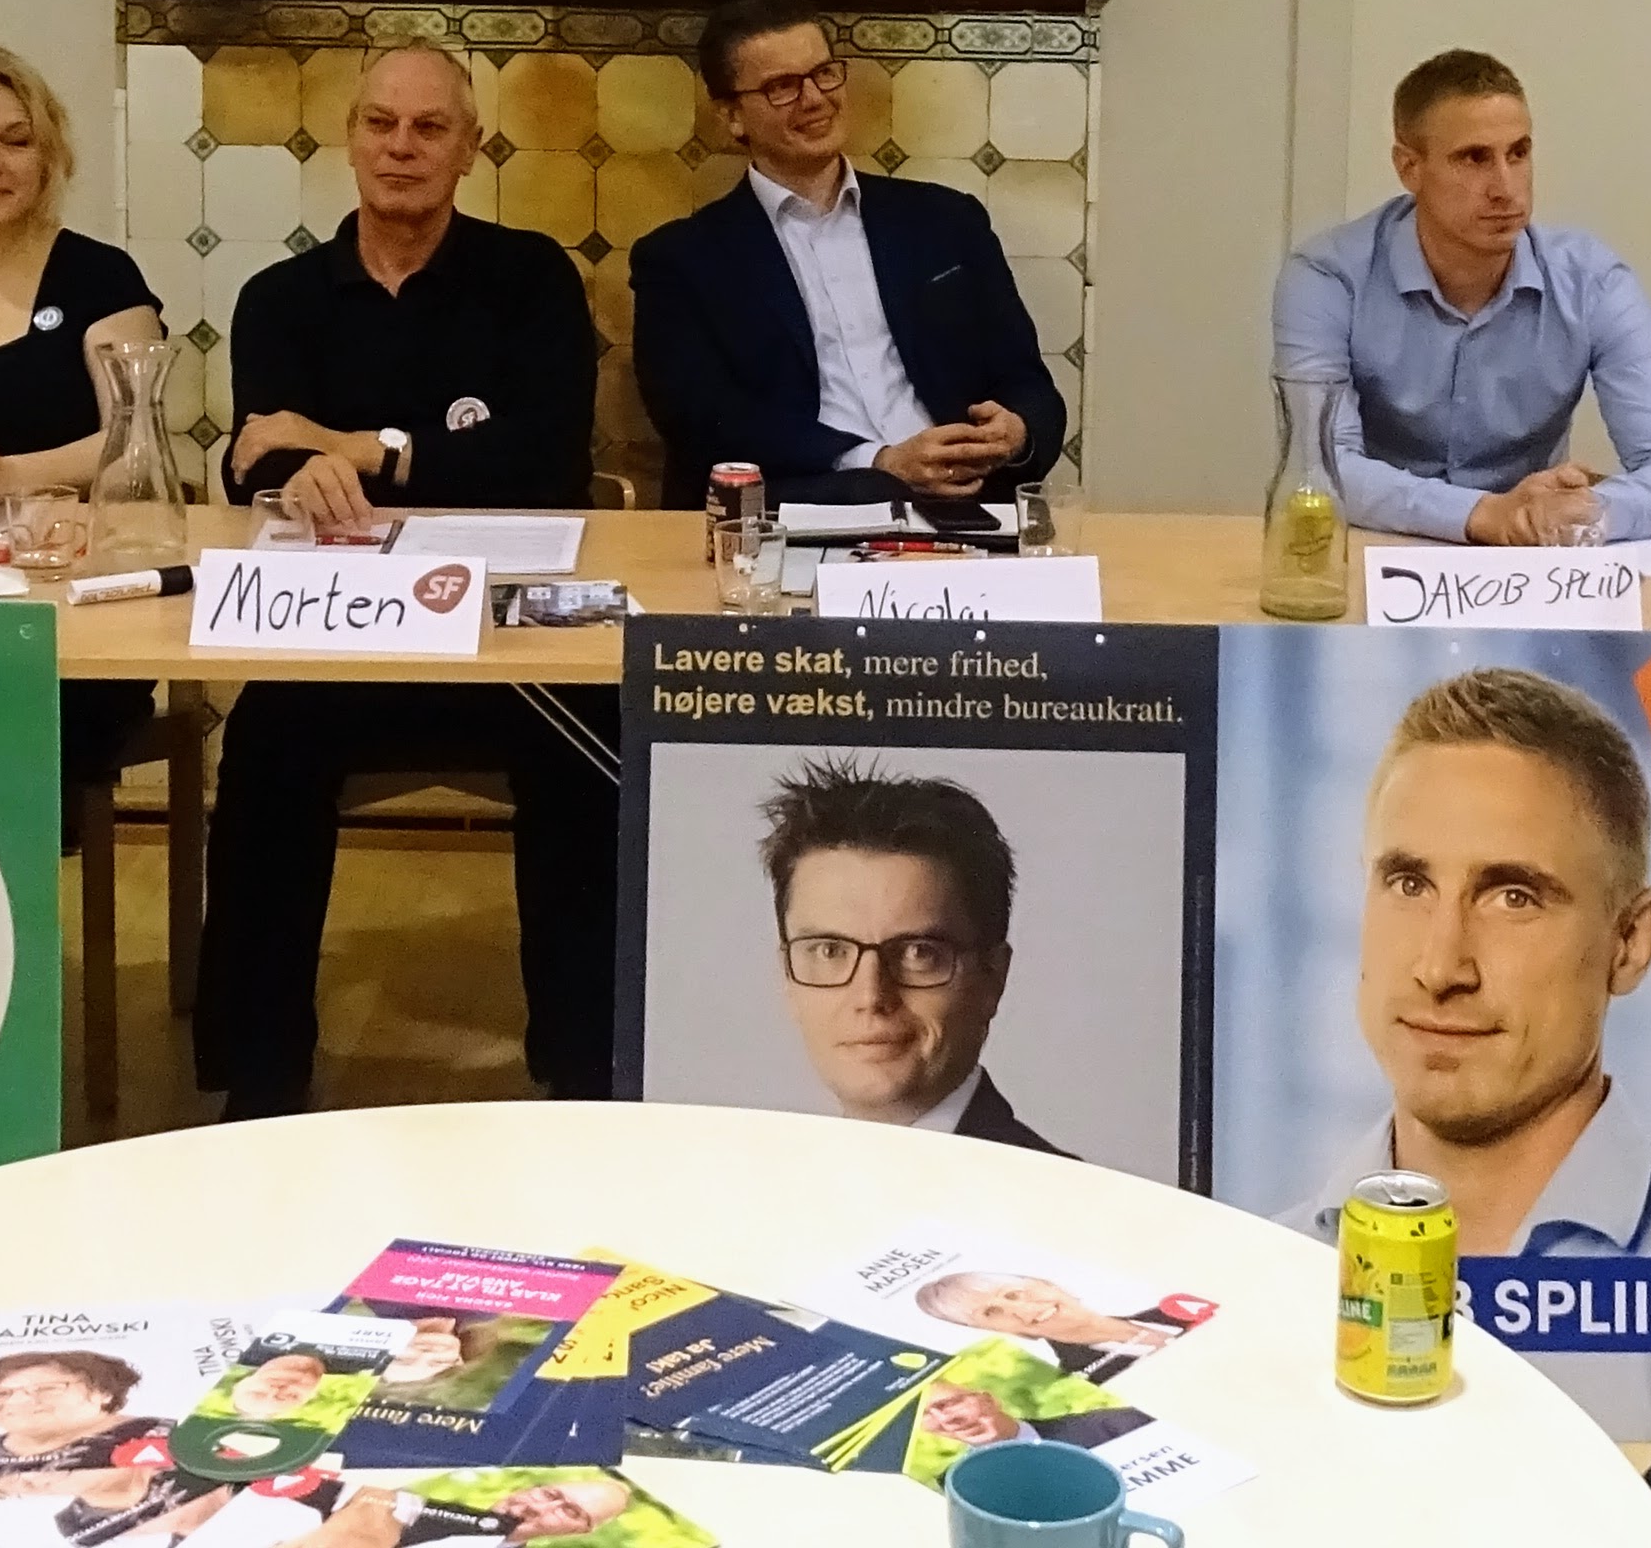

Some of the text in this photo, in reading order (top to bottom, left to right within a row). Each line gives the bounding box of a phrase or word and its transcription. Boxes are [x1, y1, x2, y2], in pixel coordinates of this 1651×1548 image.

[209, 562, 406, 633] Morten
[423, 573, 464, 601] SF
[1380, 566, 1531, 623] JAKOB
[653, 645, 1048, 683] Lavere skat, mere frihed,
[652, 685, 1184, 725] højere vækst, mindre bureaukrati.
[857, 1249, 912, 1280] ANNE
[865, 1249, 942, 1293] MADSEN
[22, 1313, 90, 1326] TINA
[685, 1338, 716, 1353] Ja
[716, 1334, 778, 1364] Mere
[416, 1415, 485, 1435] Mere
